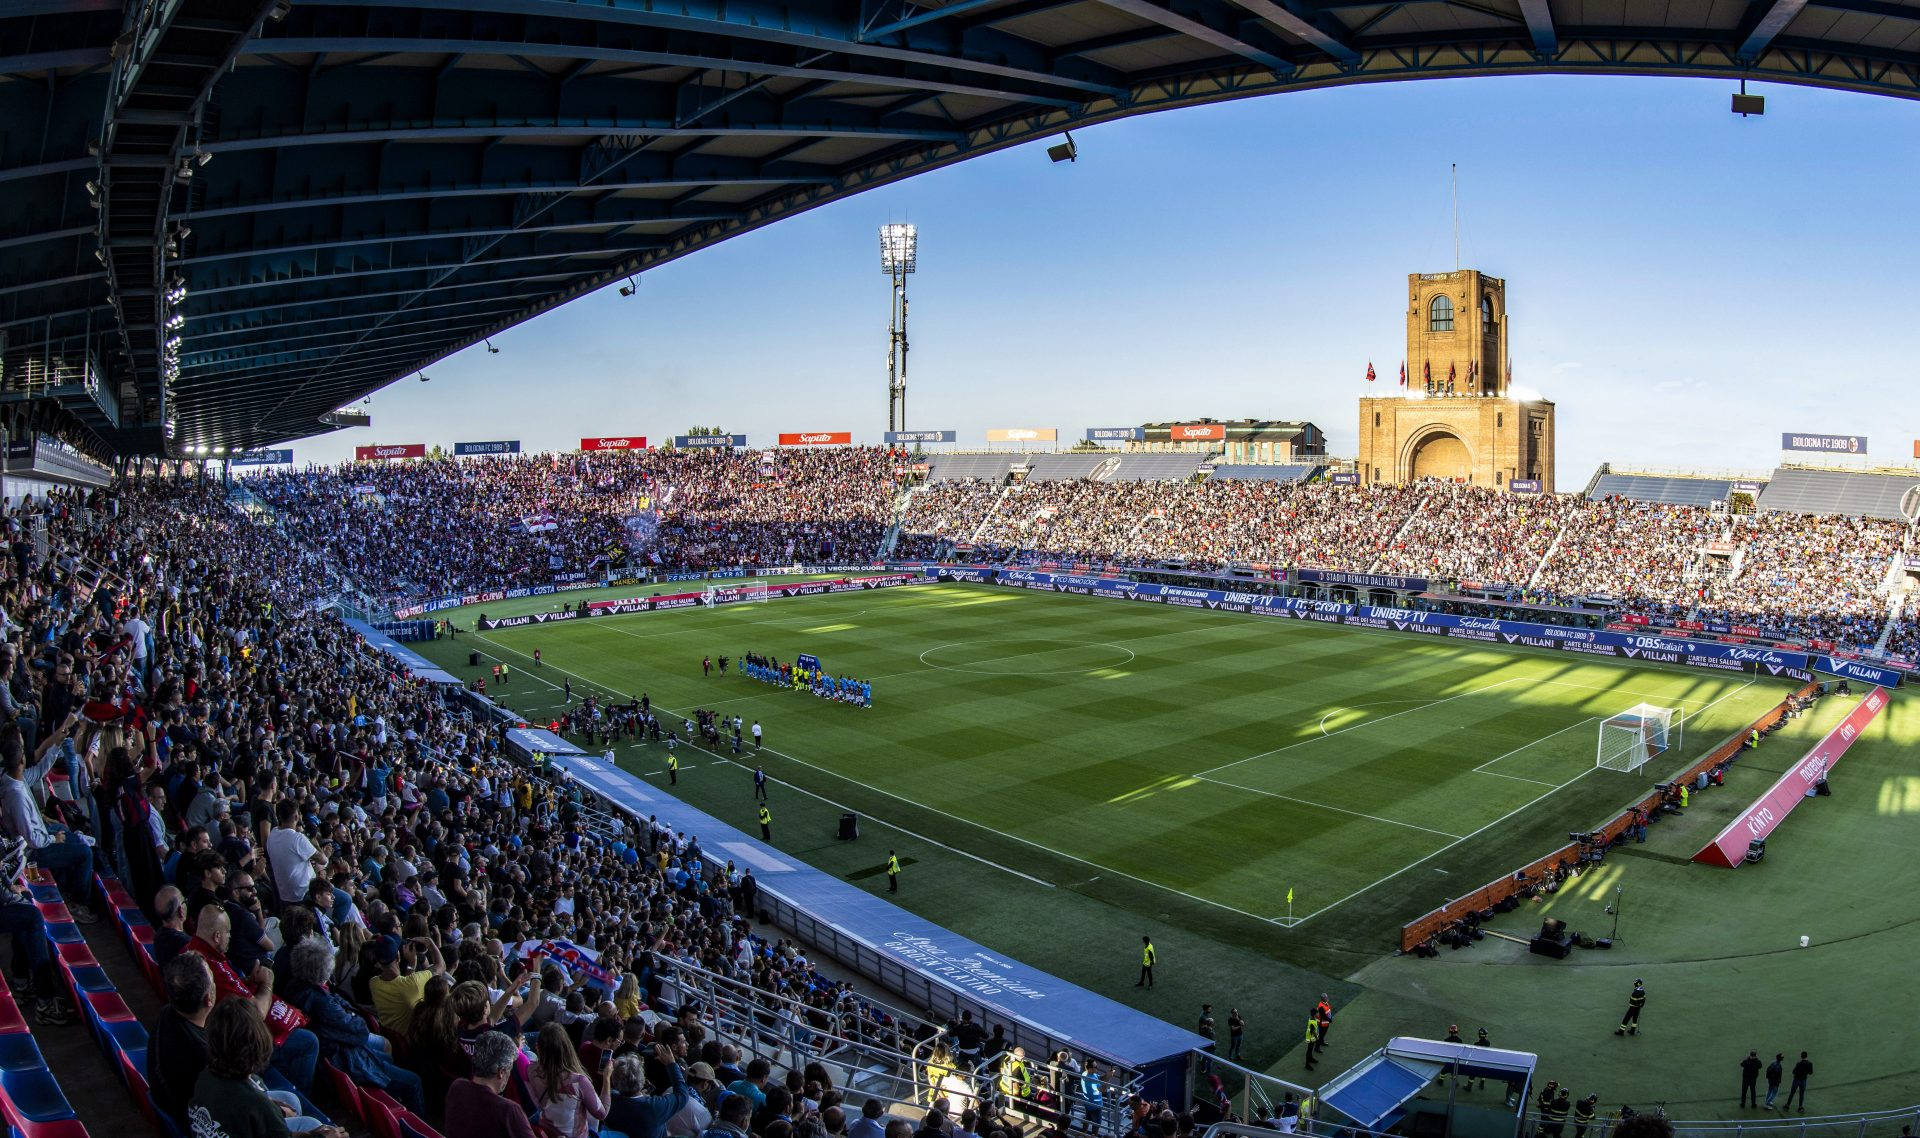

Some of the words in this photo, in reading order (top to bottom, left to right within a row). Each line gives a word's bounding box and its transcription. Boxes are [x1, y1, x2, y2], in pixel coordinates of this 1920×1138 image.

[798, 433, 832, 444] Saputo
[1094, 430, 1113, 438] BOLOGNA
[1181, 427, 1213, 440] Saputo
[597, 438, 630, 449] Saputo
[688, 437, 707, 446] BOLOGNA
[708, 437, 714, 445] FC
[714, 437, 726, 445] 1909
[1792, 436, 1821, 448] BOLOGNA
[1822, 438, 1830, 448] FC
[1831, 439, 1847, 449] 1909
[374, 446, 407, 458] Saputo
[465, 444, 485, 453] BOLOGNA
[485, 443, 491, 452] FC
[491, 443, 503, 451] 1909
[613, 578, 640, 586] MANIERE
[879, 579, 902, 588] VILLANI
[965, 574, 984, 582] VILLANI
[1326, 574, 1346, 583] STADIO
[1347, 575, 1369, 585] RENATO
[1370, 577, 1399, 587] DALL'ARA
[556, 582, 601, 591] COMMANDOS
[799, 587, 824, 595] VILLANI
[1068, 586, 1088, 594] VILLANI
[506, 588, 531, 600] ANDREA
[533, 585, 555, 596] COSTA
[714, 594, 740, 602] VILLANI
[1139, 594, 1162, 602] VILLANI
[1181, 590, 1208, 598] HOLLAND
[429, 603, 437, 612] LA
[438, 598, 460, 610] NOSTRA
[462, 595, 480, 606] FEDE
[482, 590, 504, 602] CURVA
[1223, 592, 1257, 604] UNIBET
[1258, 596, 1274, 606] TV
[621, 603, 650, 612] VILLANI
[1220, 603, 1245, 612] VILLANI
[549, 611, 577, 621] VILLANI
[1309, 612, 1338, 622] VILLANI
[1370, 607, 1407, 620] UNIBET
[1408, 611, 1428, 622] TV
[501, 616, 530, 627] VILLANI
[1459, 617, 1501, 631] Selenella
[1410, 624, 1441, 635] VILLANI
[1449, 627, 1466, 635] L'ARTE
[1476, 630, 1496, 638] SALUMI
[1544, 628, 1567, 639] BOLOGNA
[1567, 630, 1575, 639] FC
[1575, 631, 1587, 640] 1909
[1736, 627, 1758, 636] ROMAGNA
[1764, 631, 1786, 639] SVIZZERA
[1520, 635, 1554, 648] VILLANI
[1563, 640, 1582, 648] L'ARTE
[1593, 643, 1614, 651] SALUMI
[1641, 650, 1678, 662] VILLANI
[1688, 655, 1707, 663] L'ARTE
[1708, 656, 1718, 664] DEI
[1719, 658, 1742, 667] SALUMI
[1734, 648, 1757, 661] Chef
[1762, 652, 1784, 664] Casa
[1785, 667, 1812, 683] VILLANI
[1848, 664, 1882, 681] VILLANI
[1866, 694, 1881, 712] moreno
[1799, 755, 1825, 782] moreno
[884, 941, 938, 967] GARDEN
[936, 965, 1002, 996] PLATINO
